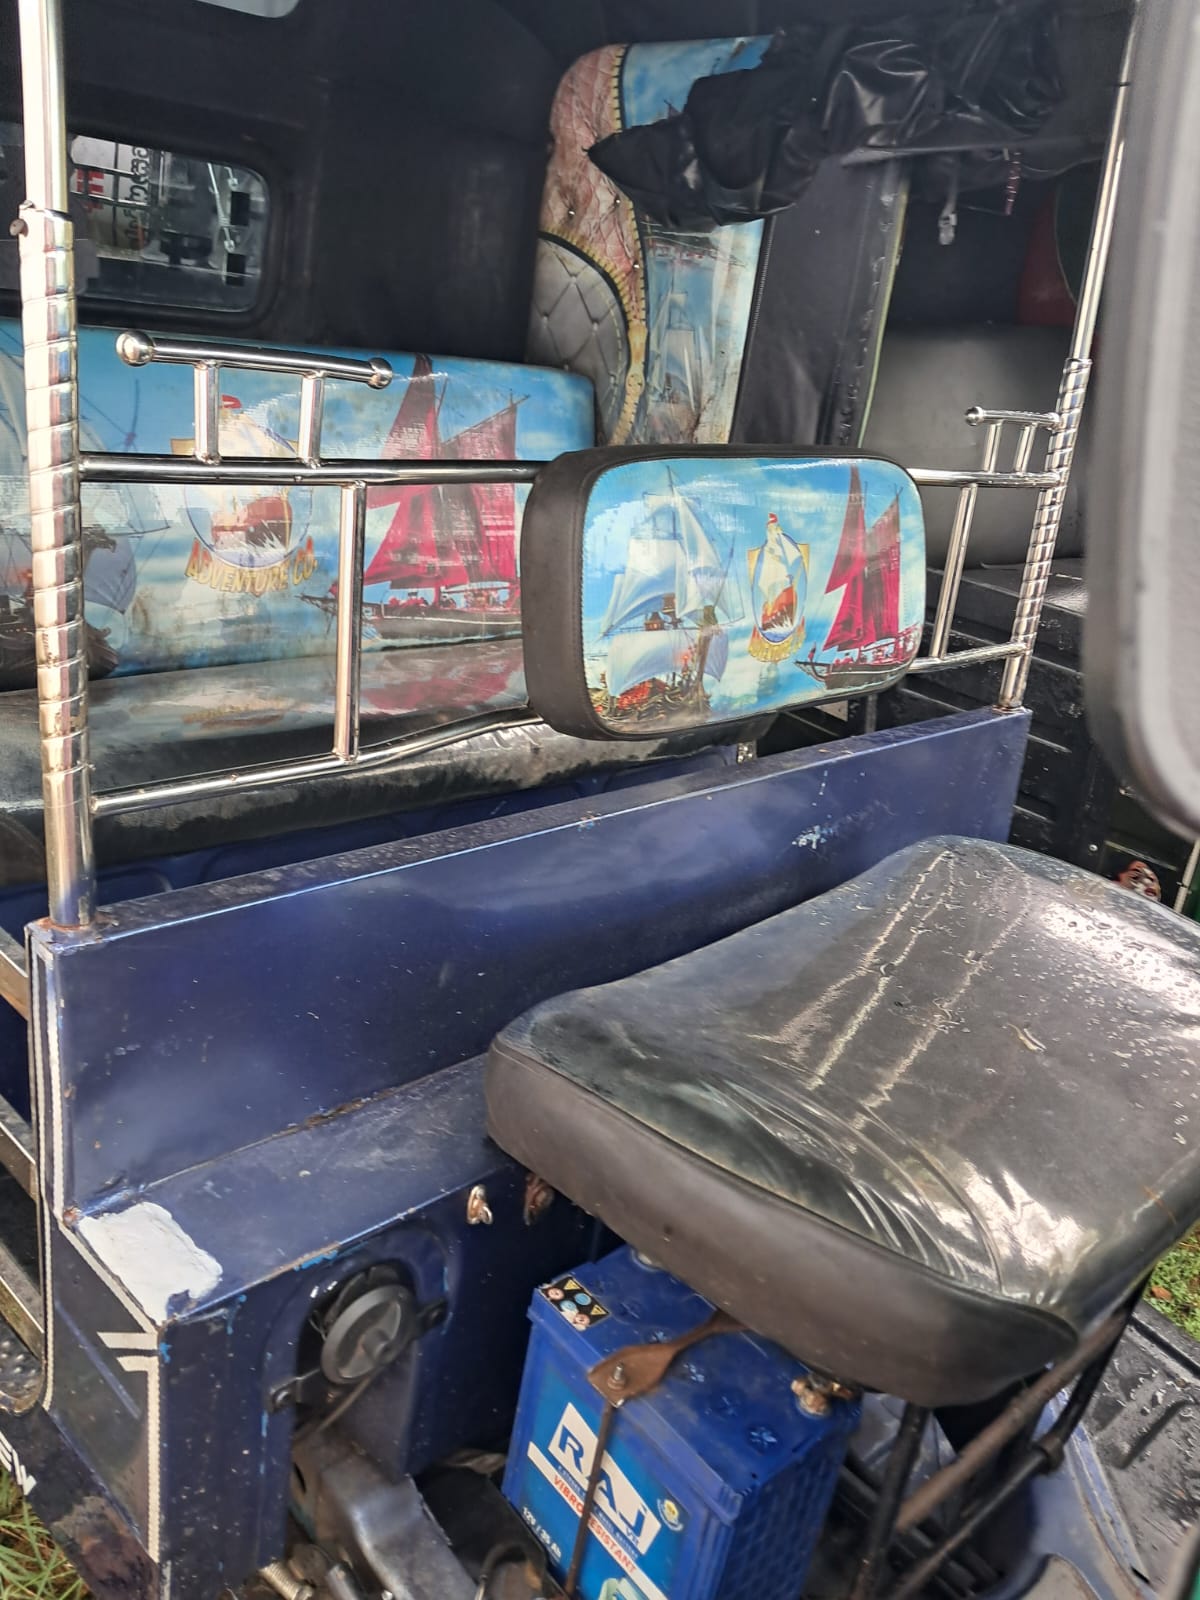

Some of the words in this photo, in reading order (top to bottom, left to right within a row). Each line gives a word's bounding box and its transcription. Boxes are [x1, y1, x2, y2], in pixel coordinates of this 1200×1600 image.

[184, 537, 290, 593] ADVENTURE
[558, 1424, 648, 1538] RAJ
[589, 1514, 637, 1574] ESISTANT
